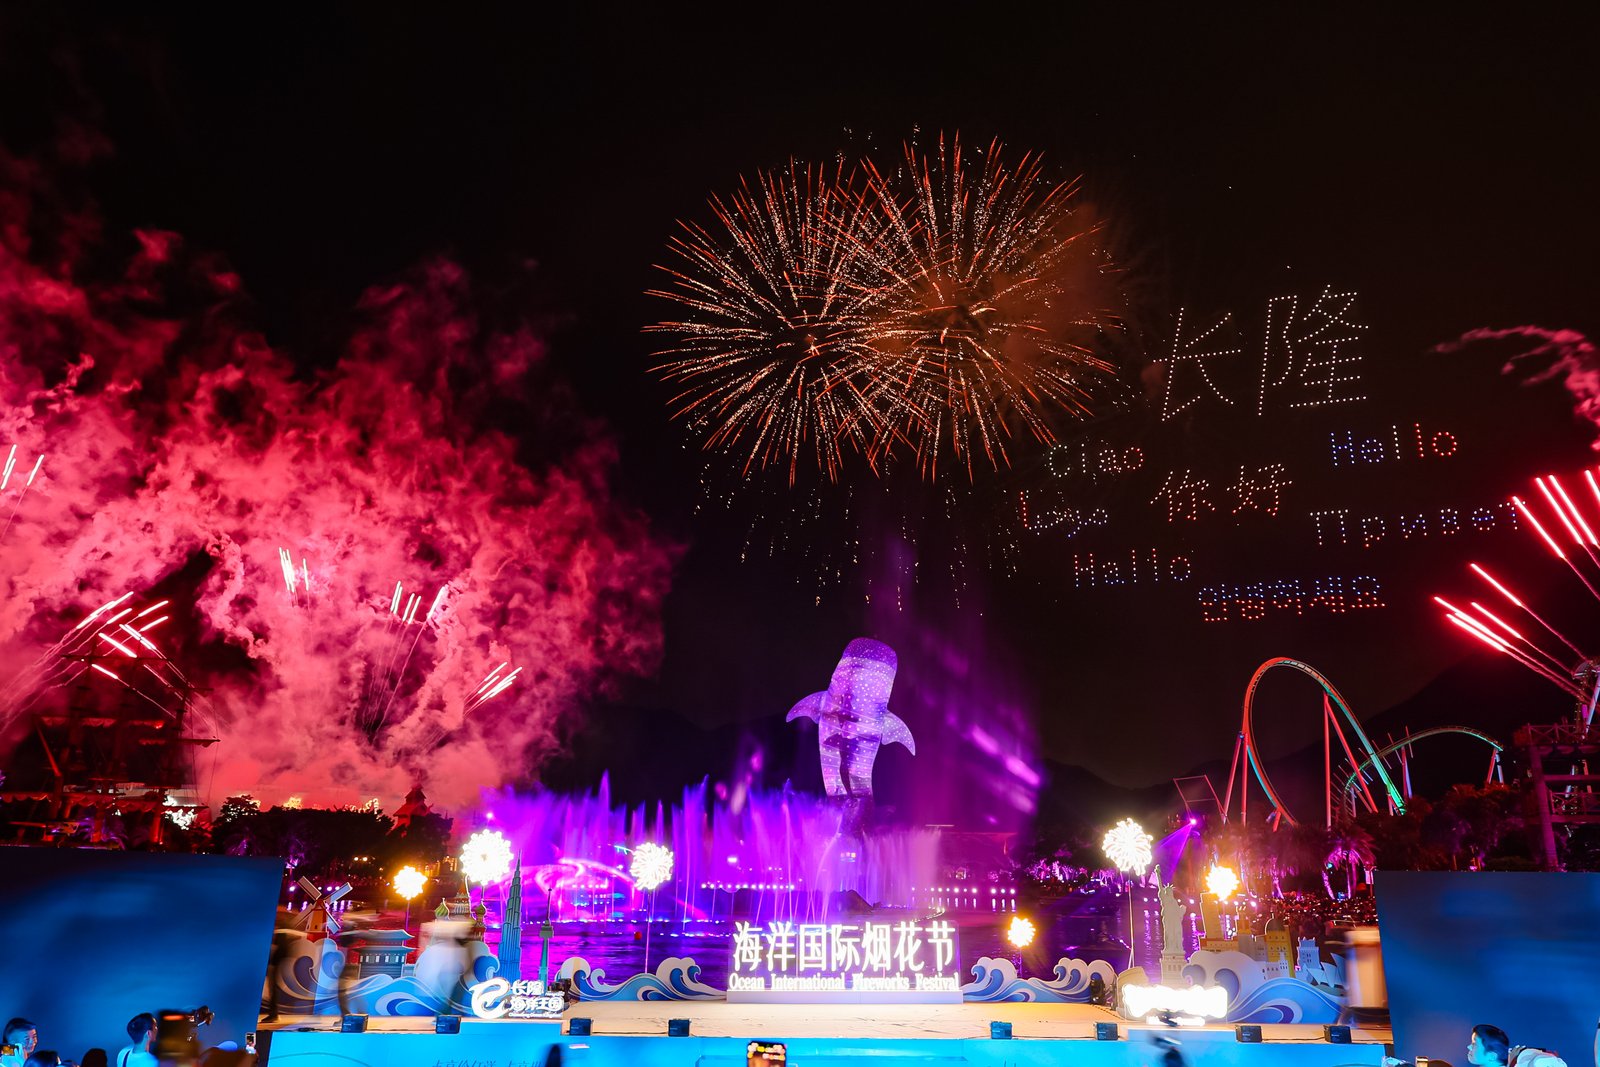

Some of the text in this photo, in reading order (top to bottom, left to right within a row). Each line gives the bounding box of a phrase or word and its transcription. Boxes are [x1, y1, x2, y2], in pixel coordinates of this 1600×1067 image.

[1152, 283, 1370, 422] 长隆
[1049, 443, 1144, 478] Ciao
[1150, 463, 1293, 522] 你好
[1074, 548, 1191, 587] Hallo
[1198, 575, 1386, 622] 안녕하세요
[733, 920, 956, 972] 海洋国际烟花节
[728, 973, 765, 990] Ocean
[770, 973, 845, 990] International
[915, 973, 960, 990] Festival
